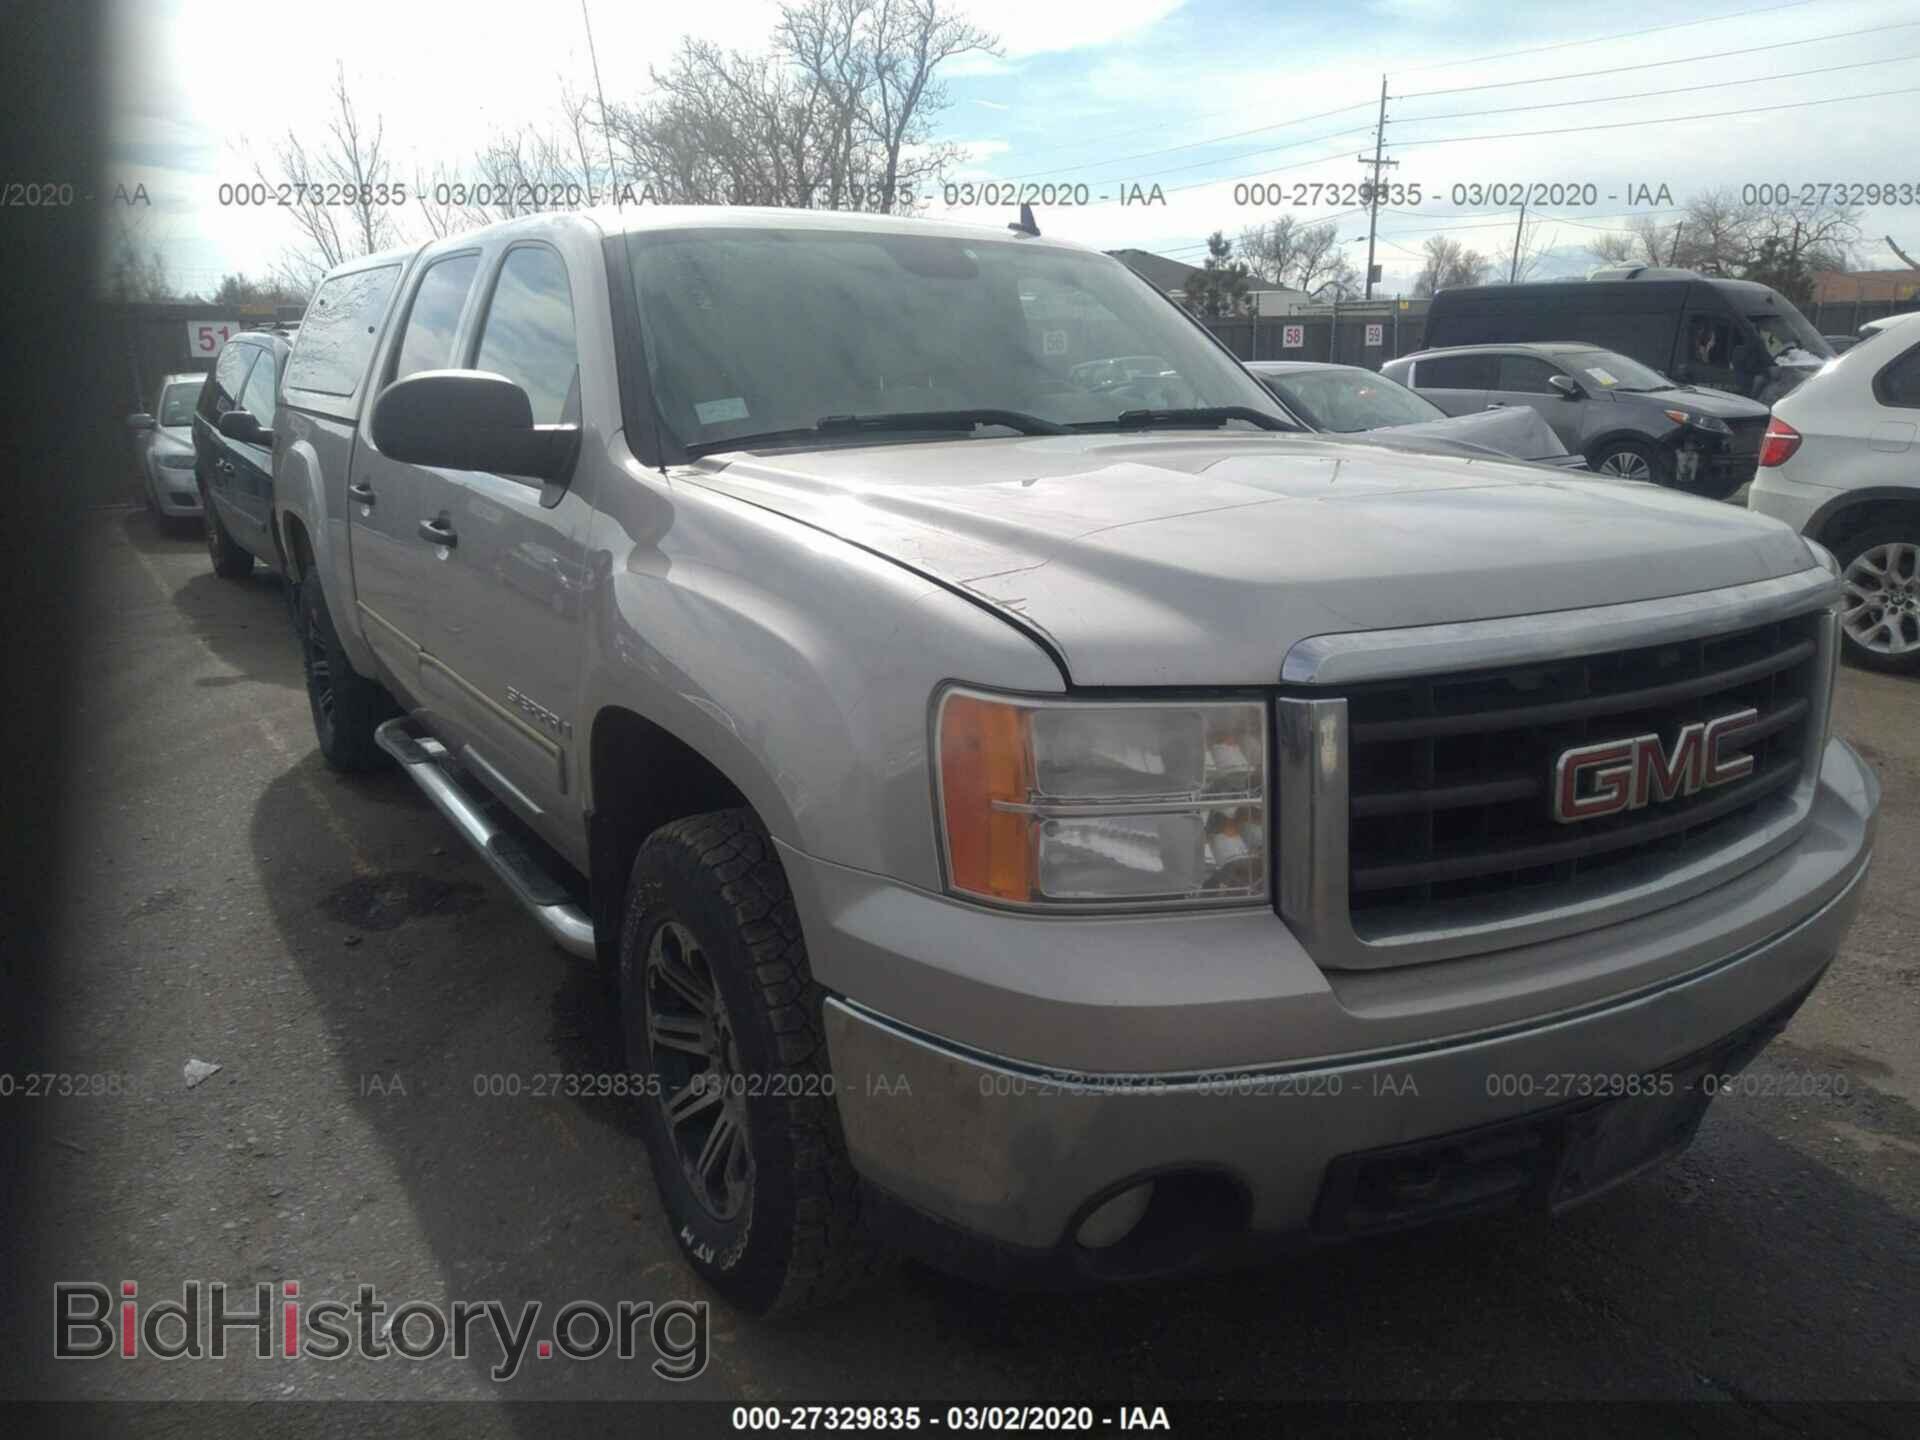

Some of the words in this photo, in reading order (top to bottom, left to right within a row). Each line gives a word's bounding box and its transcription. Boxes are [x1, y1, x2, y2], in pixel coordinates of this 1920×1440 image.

[198, 326, 230, 351] 51
[1286, 328, 1301, 344] 58
[1555, 708, 1757, 824] GMC
